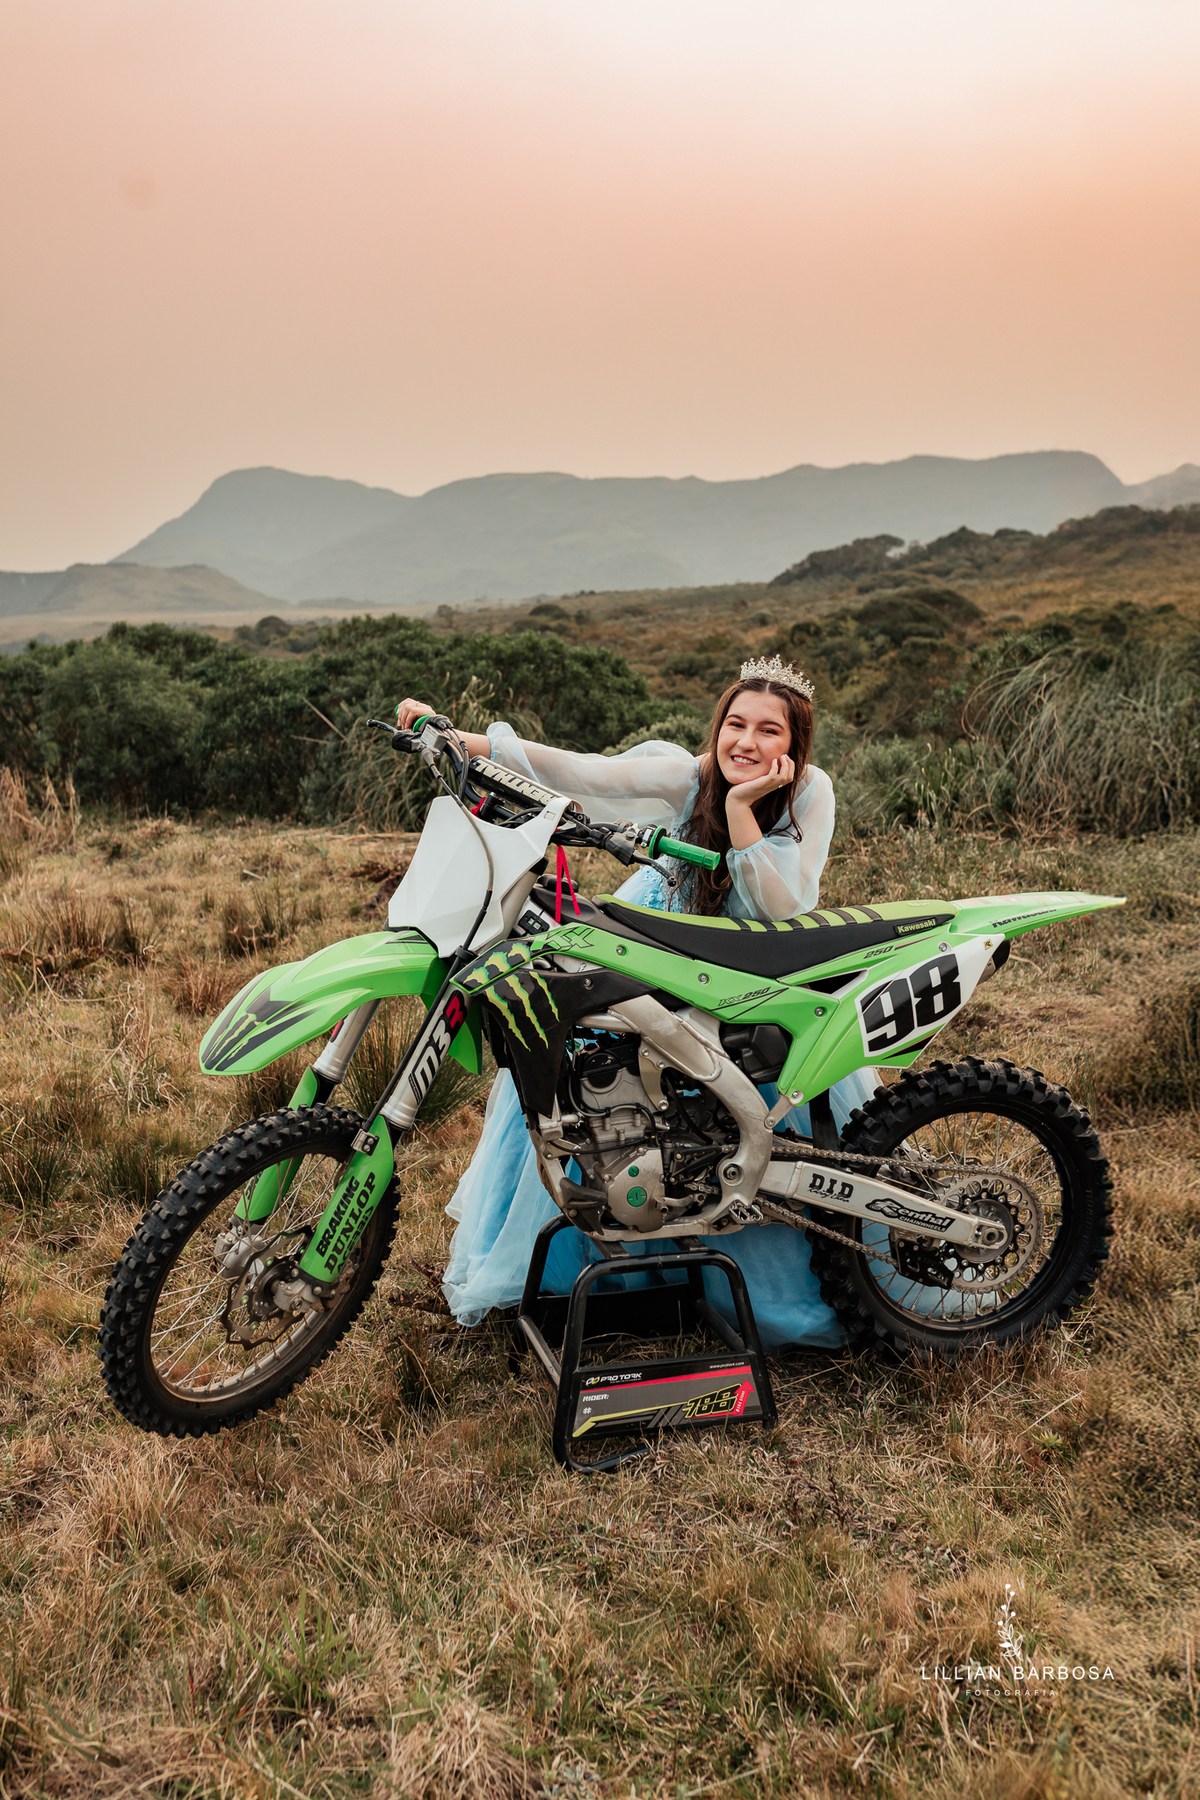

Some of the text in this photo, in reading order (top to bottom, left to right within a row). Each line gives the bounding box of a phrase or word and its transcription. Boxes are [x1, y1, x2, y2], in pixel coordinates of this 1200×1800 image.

[897, 918, 937, 934] Kawasaki
[863, 945, 895, 960] 250
[860, 952, 962, 1053] 98
[316, 1175, 360, 1258] BRAKING
[324, 1171, 376, 1275] DUNLOP
[899, 1215, 947, 1232] CHAINWHEELS
[582, 1393, 610, 1402] RIDER:
